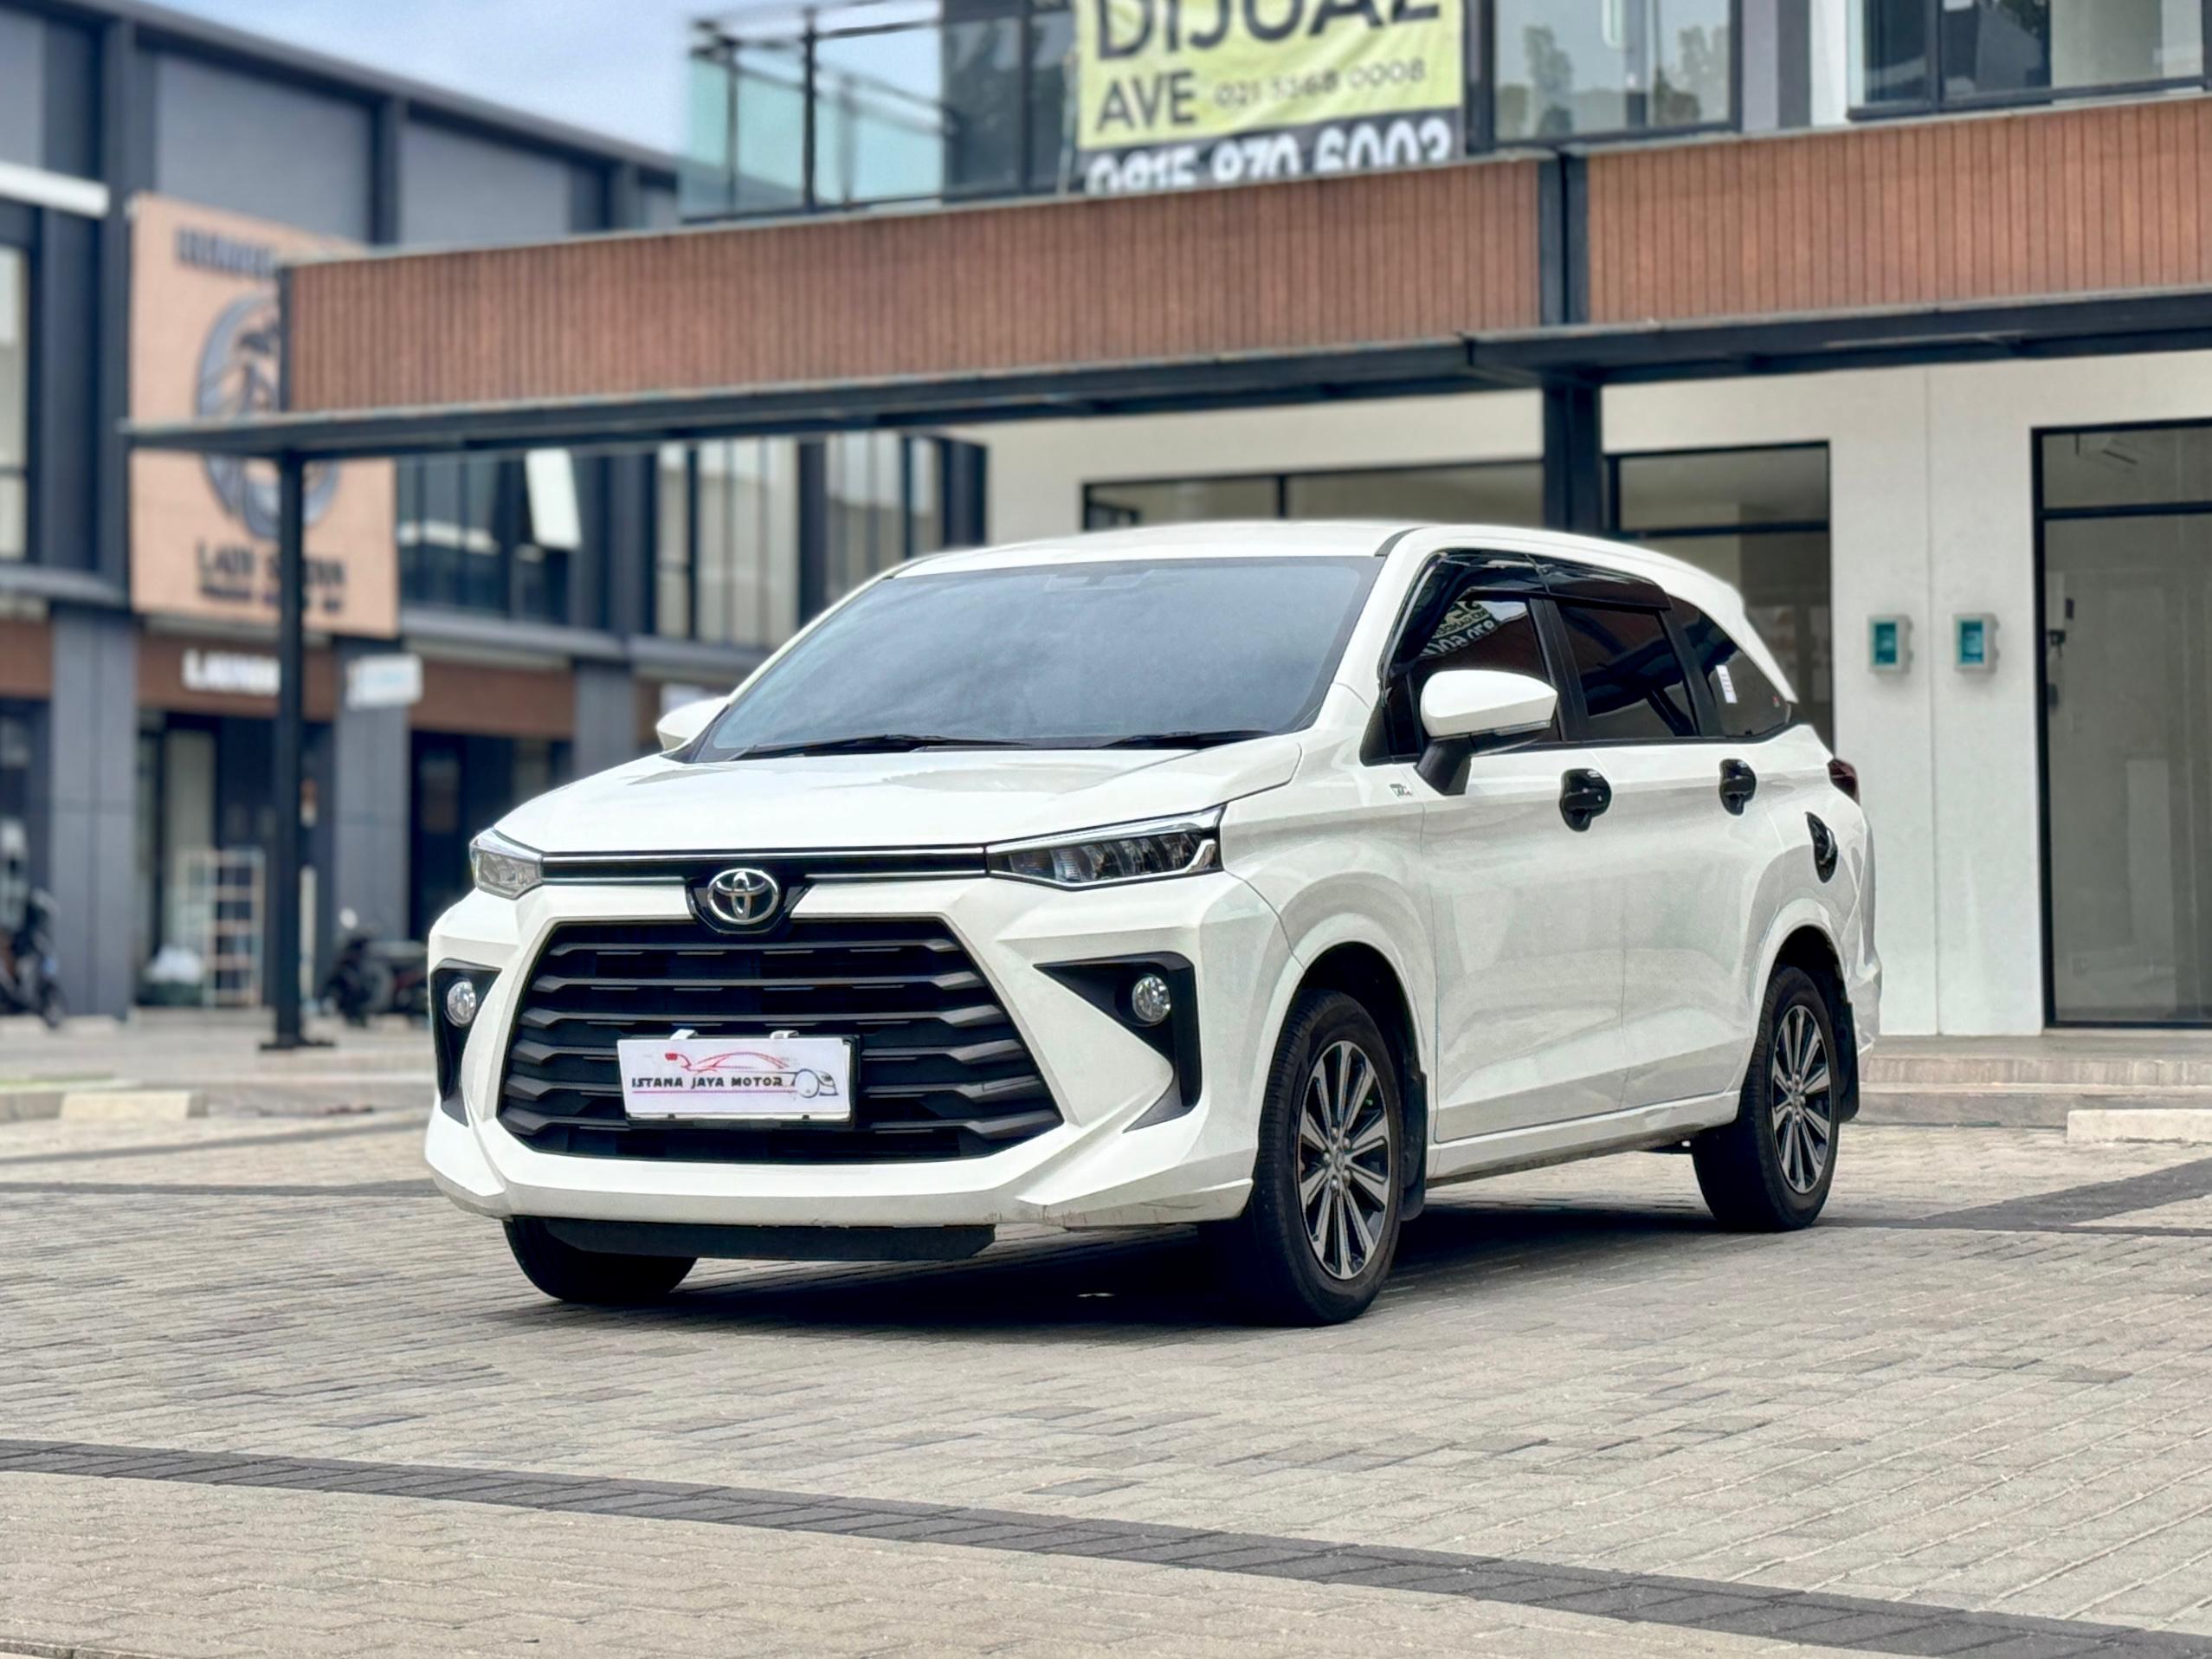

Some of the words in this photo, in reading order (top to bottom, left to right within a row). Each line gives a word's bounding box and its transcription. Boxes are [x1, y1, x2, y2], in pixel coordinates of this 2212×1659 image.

[1096, 71, 1196, 132] AVE
[631, 1076, 684, 1088] ISTANA
[691, 1076, 725, 1090] JAYA
[731, 1076, 783, 1088] MOTOR
